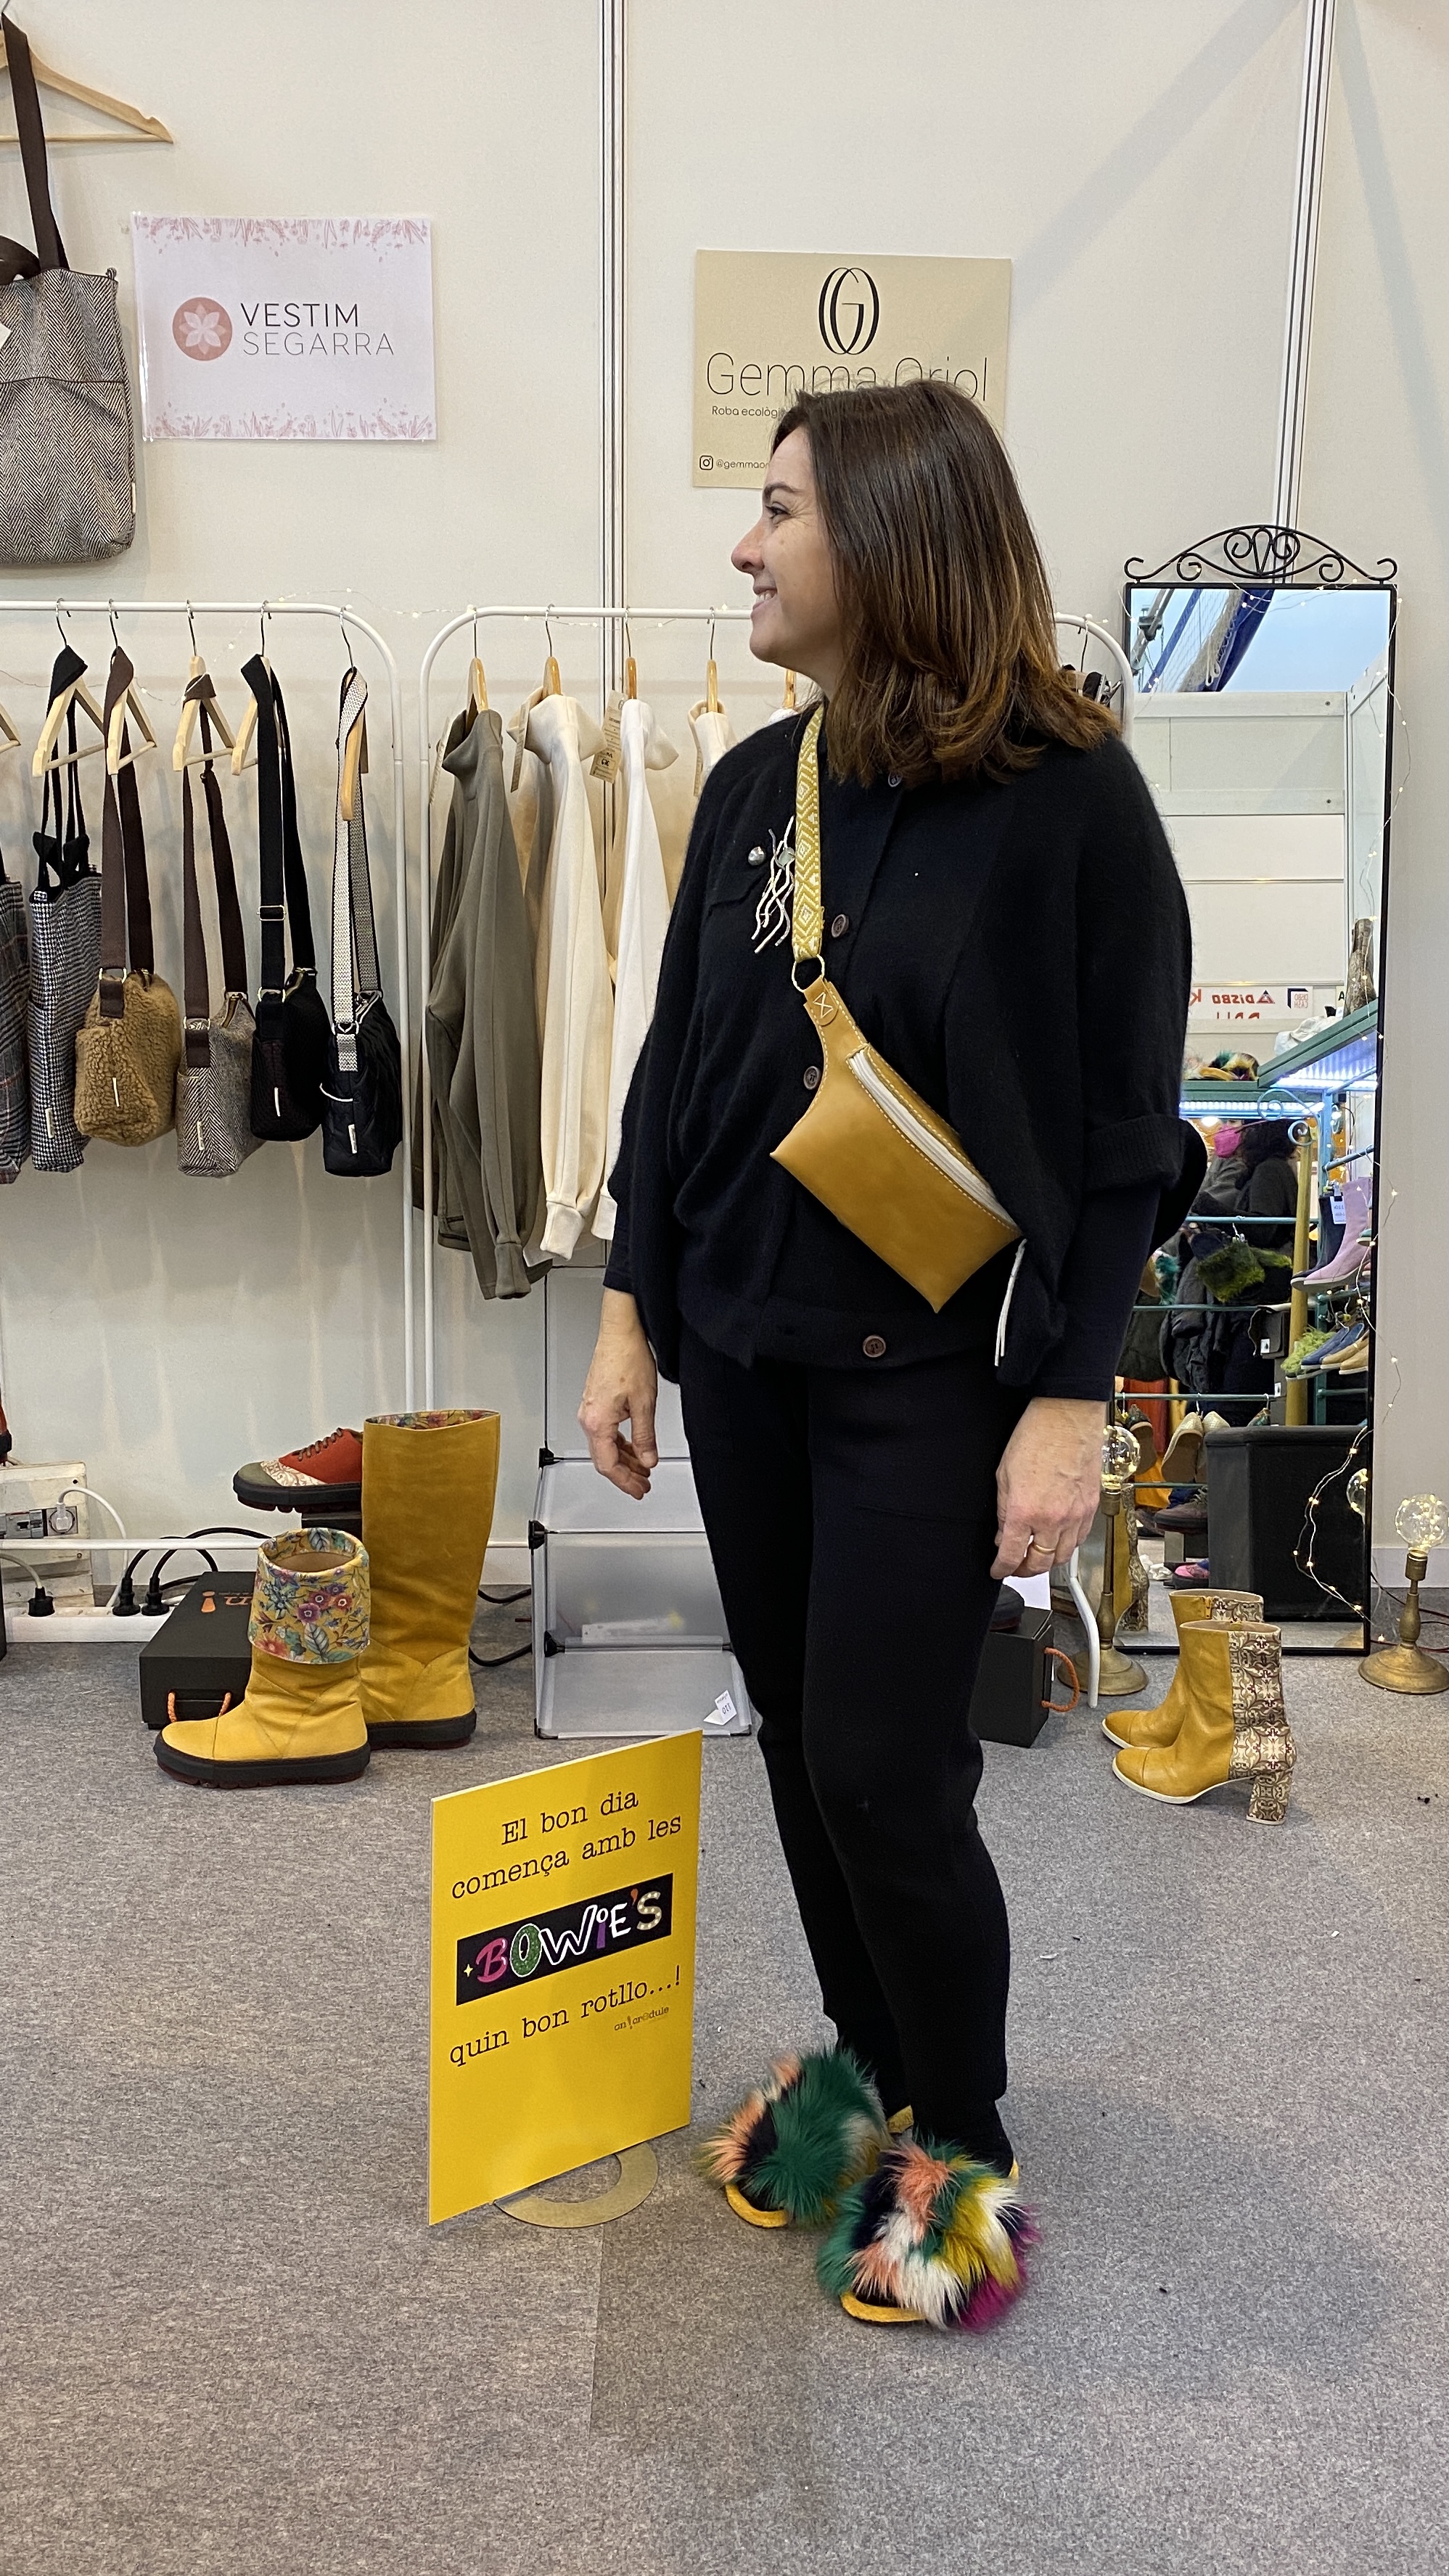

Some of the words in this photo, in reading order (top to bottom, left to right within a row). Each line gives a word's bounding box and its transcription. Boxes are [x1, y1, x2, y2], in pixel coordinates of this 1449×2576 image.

[240, 302, 358, 328] VESTIM
[242, 331, 395, 356] SEGARRA
[706, 352, 877, 397] Gemma
[711, 405, 739, 416] Roba
[501, 1817, 528, 1845] El
[541, 1806, 588, 1834] bon
[600, 1789, 639, 1816] dia
[451, 1850, 570, 1899] comença
[581, 1826, 636, 1861] amb
[647, 1815, 682, 1842] les
[449, 2029, 510, 2067] quin
[521, 2008, 570, 2039] bon
[580, 1964, 681, 2019] rotllo...!
